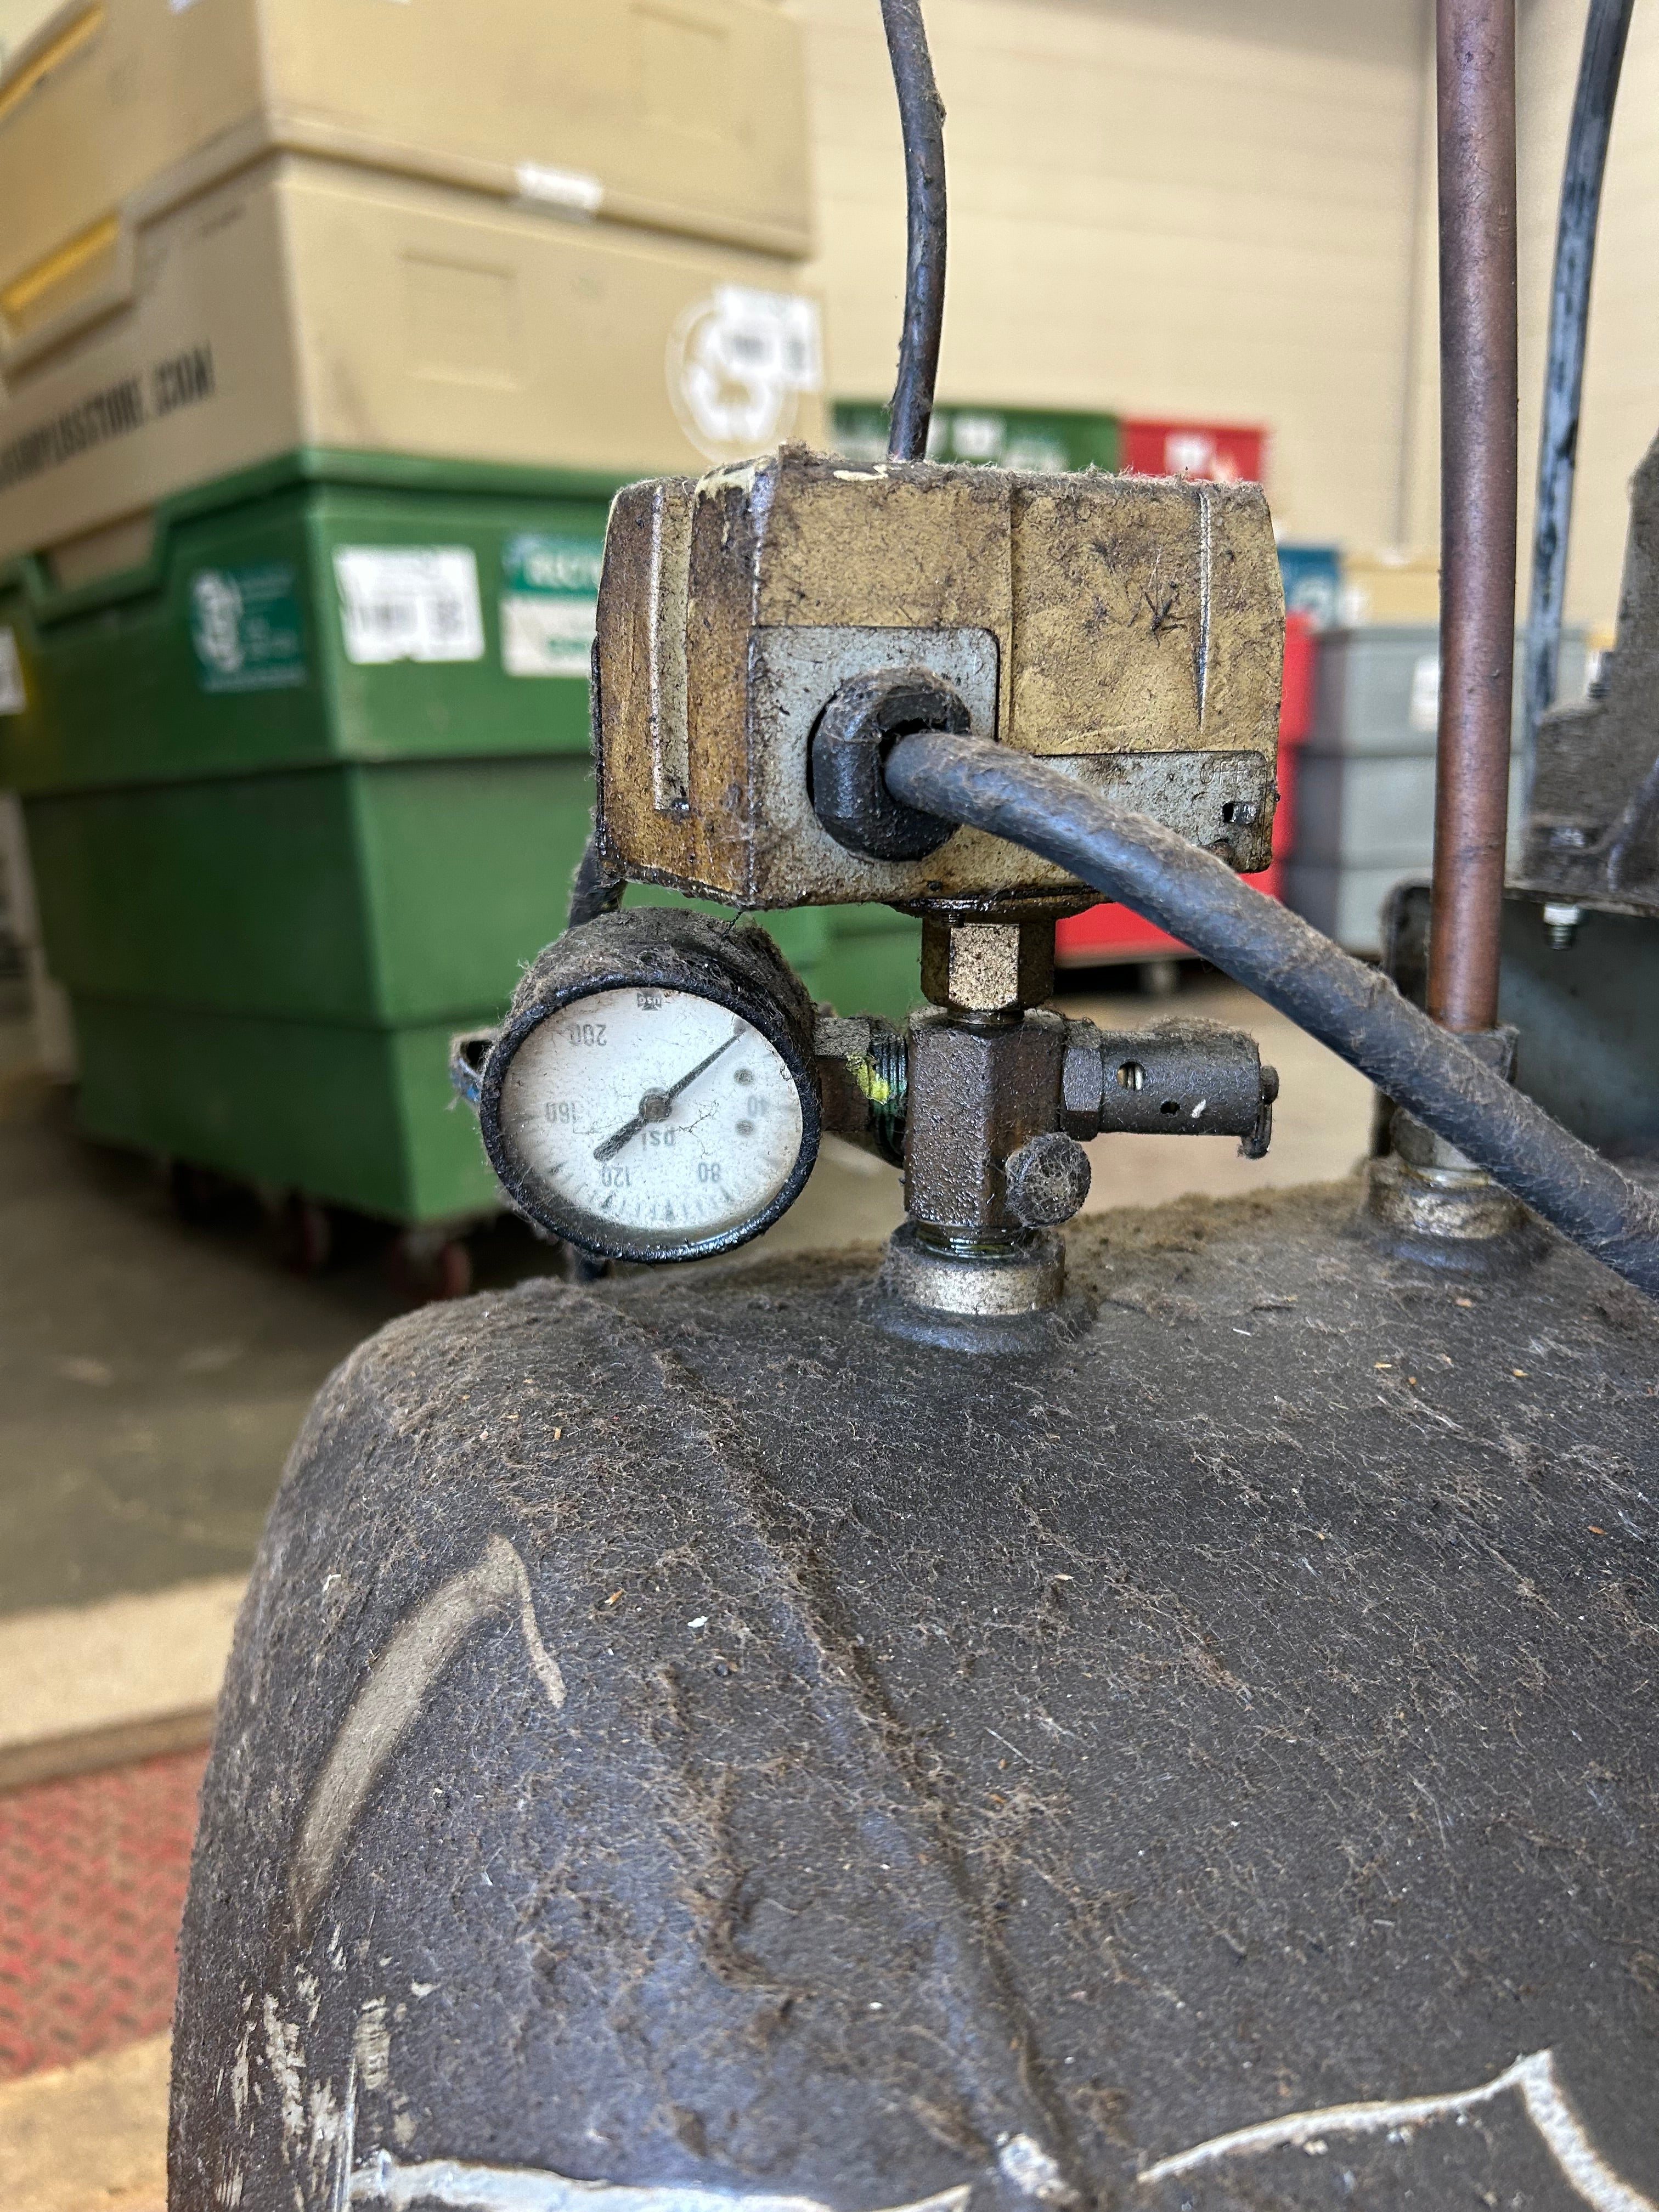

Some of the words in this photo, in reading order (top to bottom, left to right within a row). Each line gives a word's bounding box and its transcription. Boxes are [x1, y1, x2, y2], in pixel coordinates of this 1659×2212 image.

[570, 1024, 607, 1047] 200
[545, 1102, 580, 1124] 160
[601, 1166, 633, 1187] 120
[698, 1161, 721, 1183] 80
